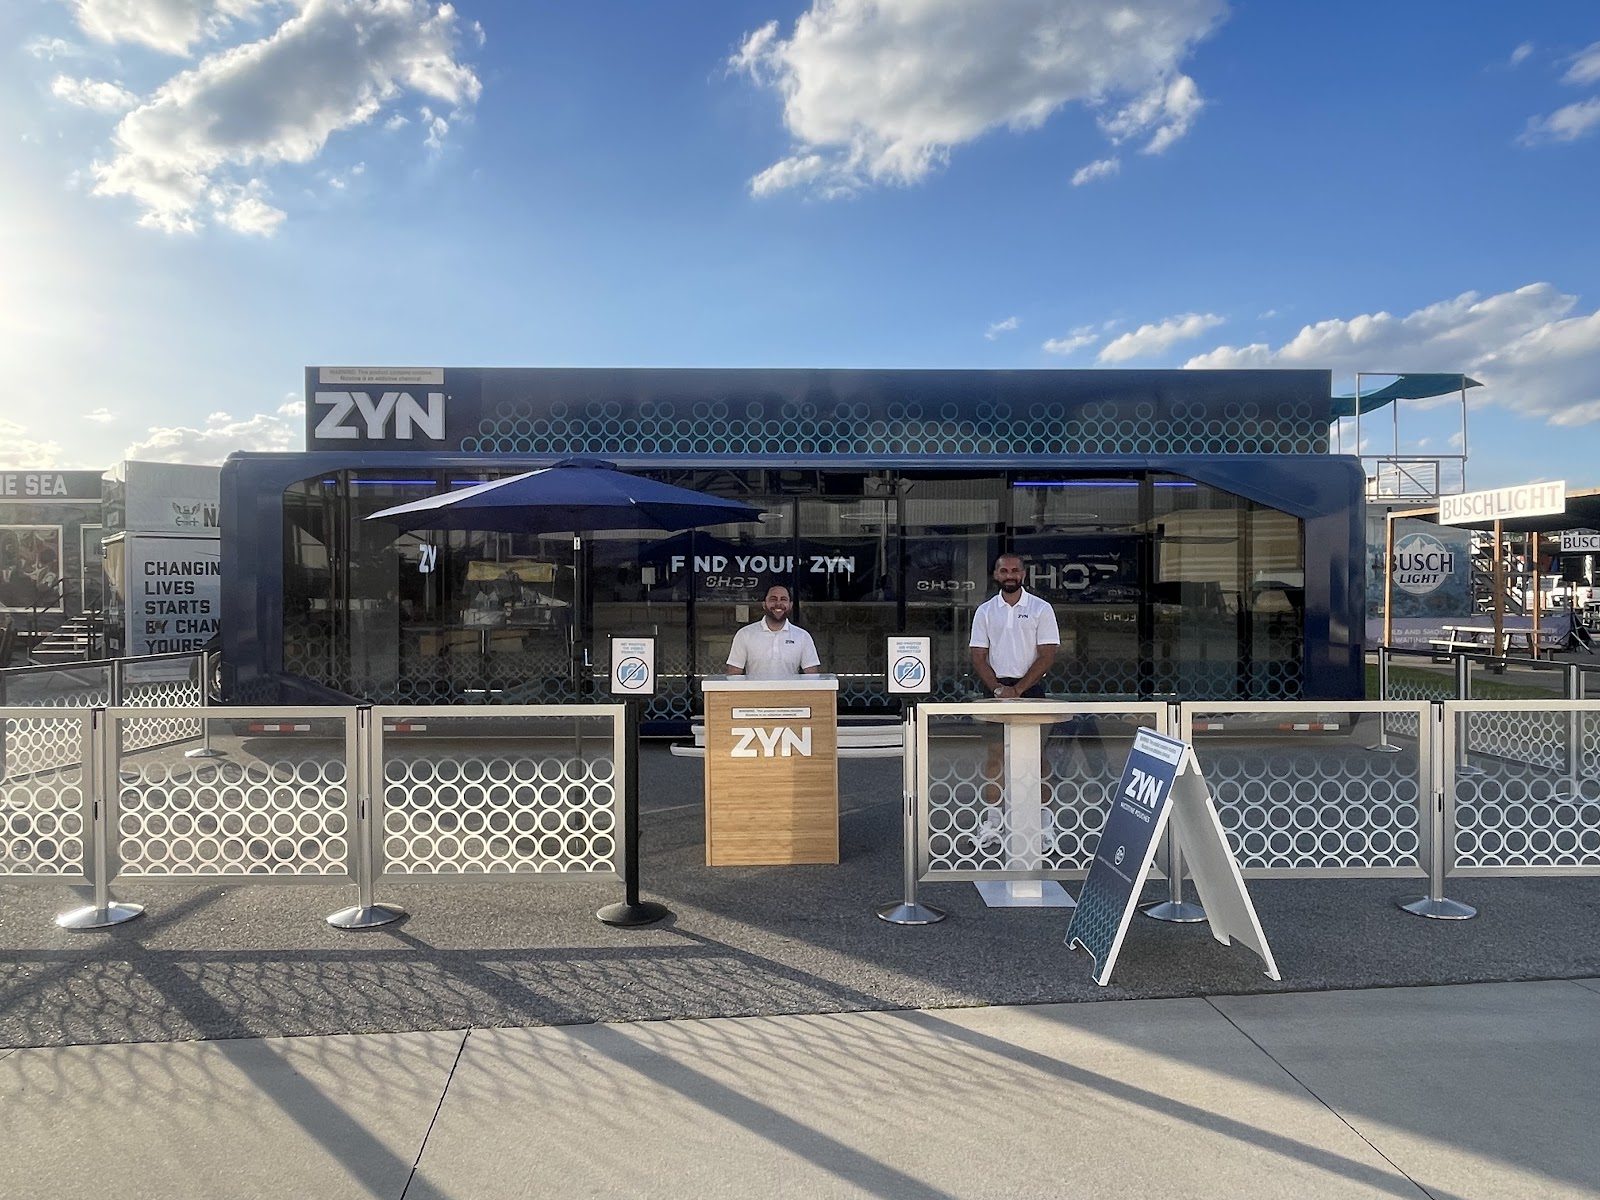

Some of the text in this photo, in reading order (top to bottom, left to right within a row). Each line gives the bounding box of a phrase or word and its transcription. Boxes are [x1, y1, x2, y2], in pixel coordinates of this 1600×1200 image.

[314, 391, 446, 439] ZYN
[25, 474, 68, 496] SEA
[1563, 536, 1600, 549] BUSC
[810, 556, 855, 573] ZYN
[1399, 574, 1440, 584] LIGHT
[144, 581, 195, 595] LIVES
[144, 600, 210, 614] STARTS
[145, 620, 169, 634] BY
[731, 727, 812, 758] ZYN
[1125, 767, 1164, 809] ZYN
